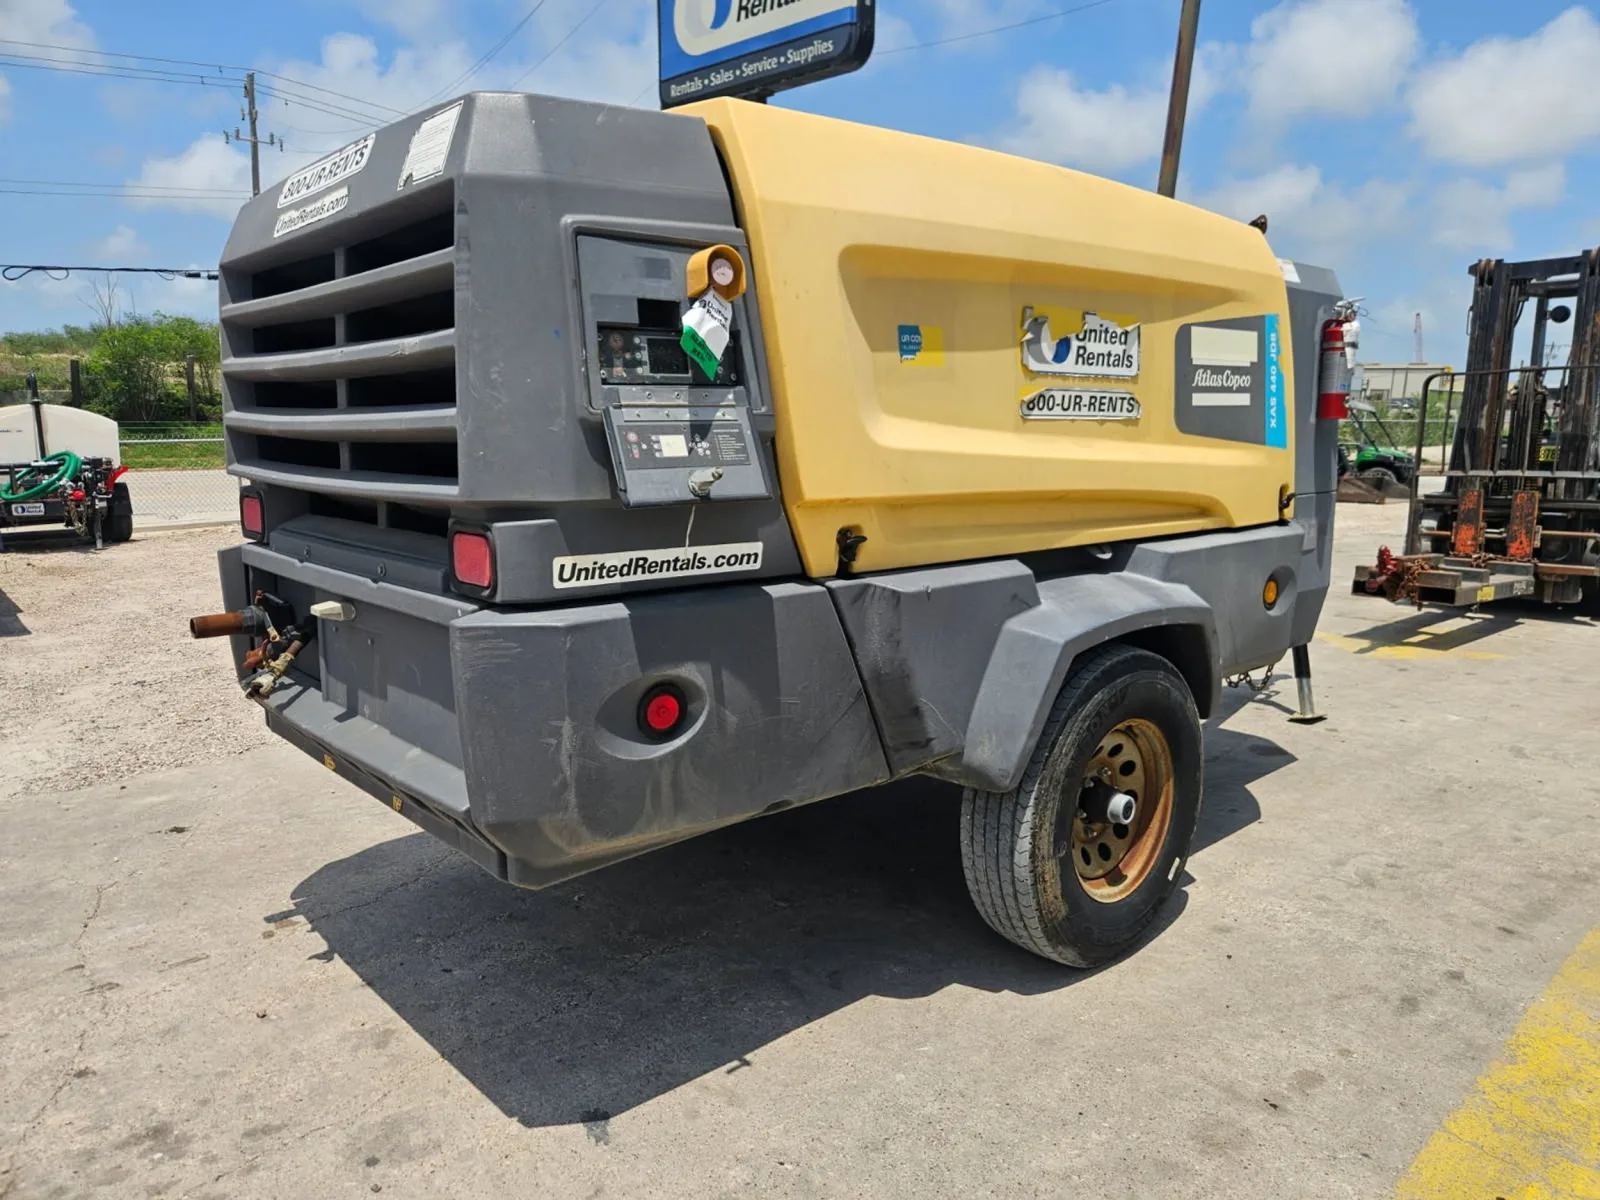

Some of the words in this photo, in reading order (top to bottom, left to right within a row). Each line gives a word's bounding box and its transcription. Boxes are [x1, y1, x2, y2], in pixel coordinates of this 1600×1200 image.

[670, 77, 703, 97] Rentals
[710, 70, 734, 86] Sales
[742, 56, 778, 77] Service
[787, 40, 834, 64] Supplies
[283, 144, 369, 199] 800-UR-RENTS
[276, 194, 348, 234] UnitedRentals.com
[1074, 345, 1134, 368] Rentals
[1026, 394, 1136, 413] 800-UR-RENTS
[558, 552, 759, 583] UnitedRentals.com
